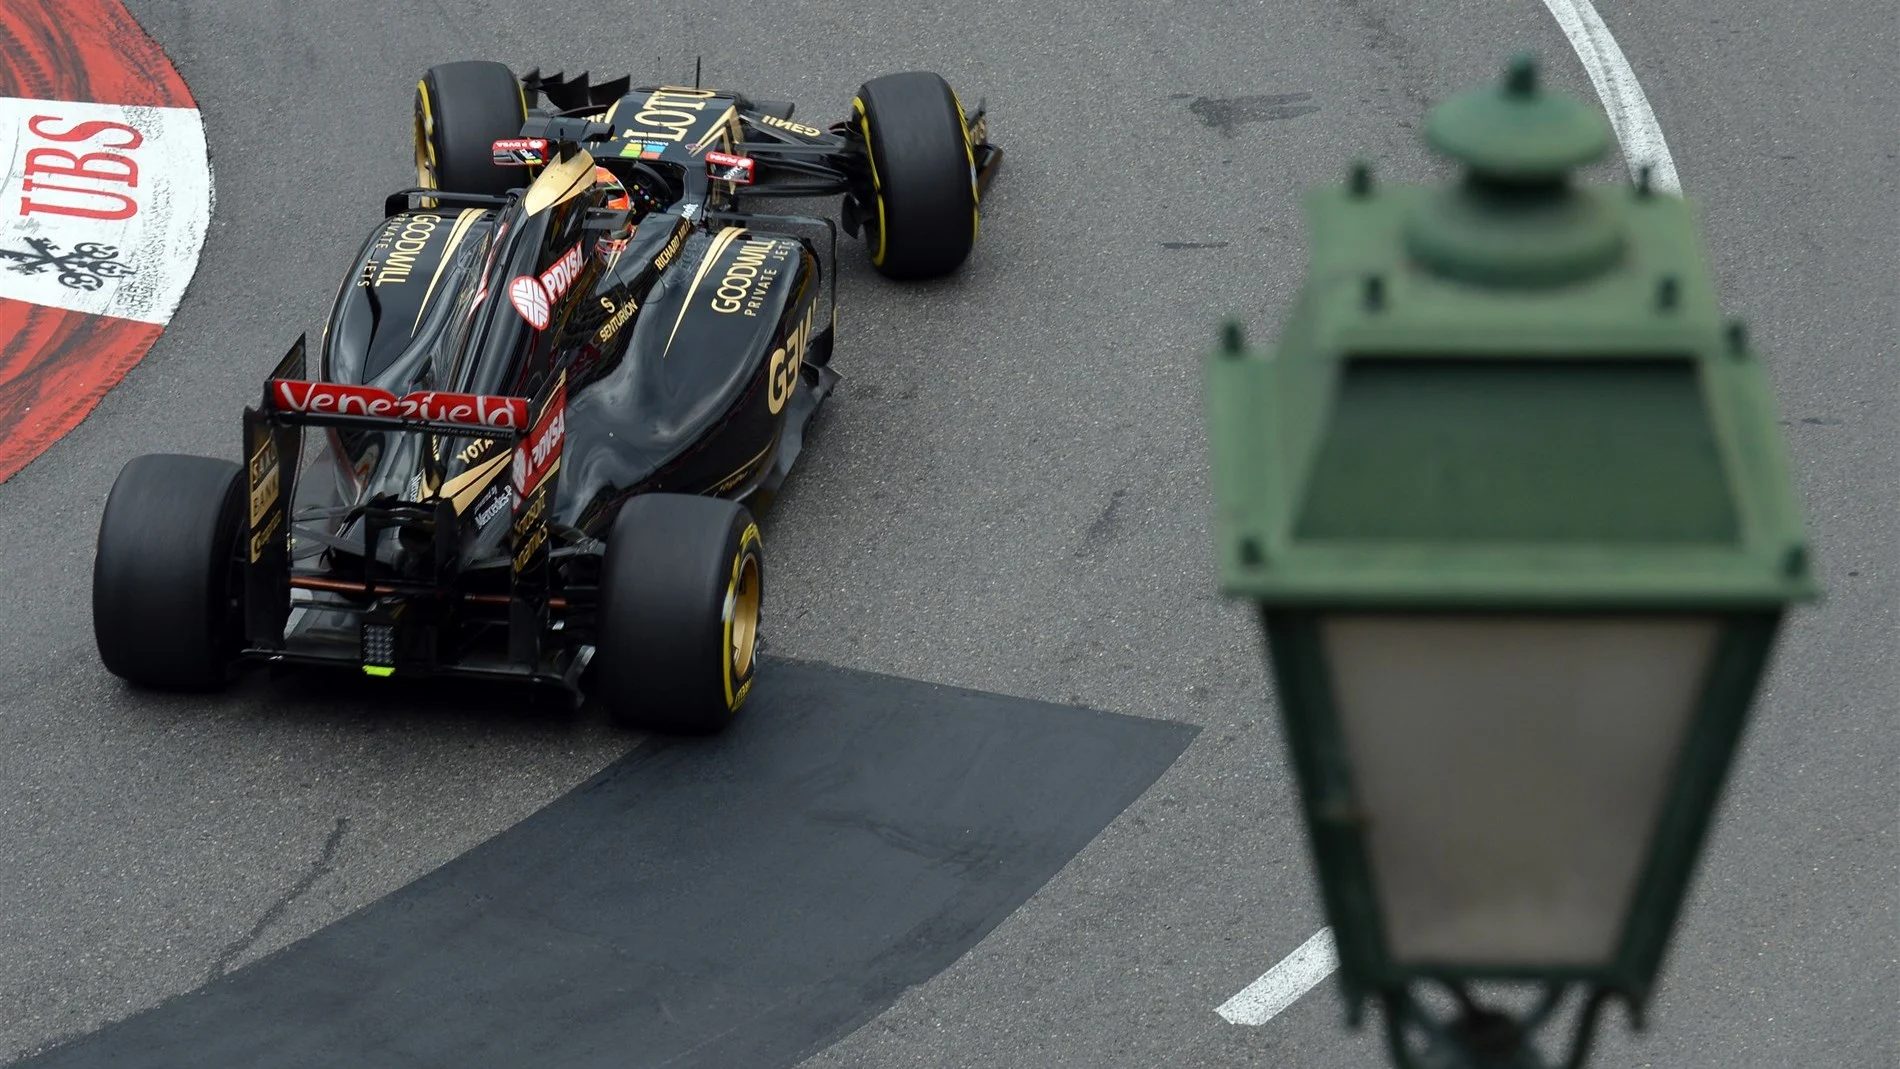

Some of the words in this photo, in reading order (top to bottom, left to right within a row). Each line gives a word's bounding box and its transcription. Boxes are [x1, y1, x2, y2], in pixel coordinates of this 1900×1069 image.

[623, 86, 716, 142] LOTU
[20, 115, 143, 221] UBS
[357, 259, 380, 287] JETS
[375, 214, 442, 287] GOODWILL
[542, 244, 584, 300] PDVSA
[655, 235, 680, 270] RICHARD
[711, 240, 777, 313] GOODWILL
[744, 269, 777, 316] PRIVATE
[600, 298, 638, 343] SENTURION
[280, 382, 515, 428] Venezuela
